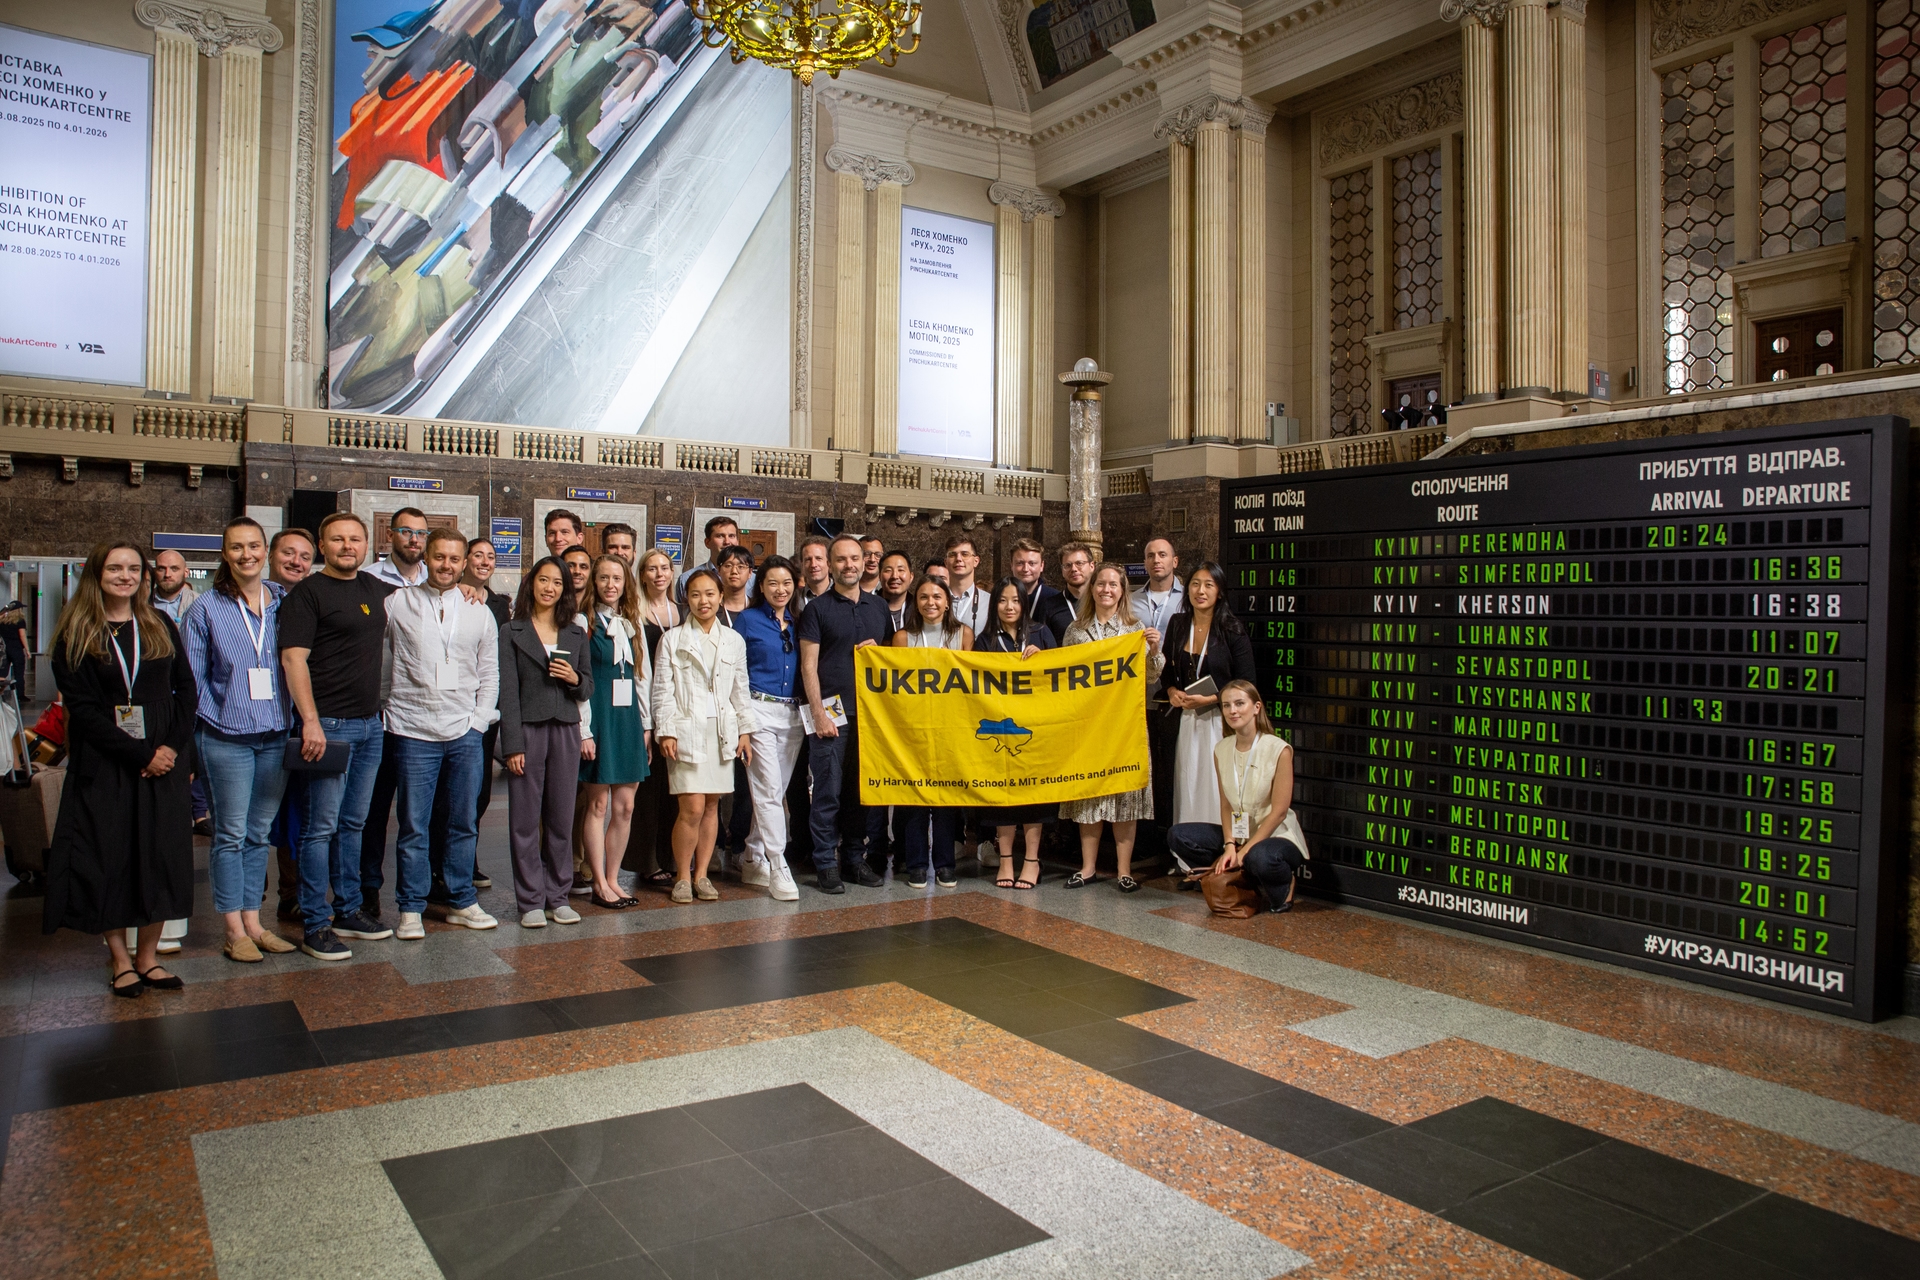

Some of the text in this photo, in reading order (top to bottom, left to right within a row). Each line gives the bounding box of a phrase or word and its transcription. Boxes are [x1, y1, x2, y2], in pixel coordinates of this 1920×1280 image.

[23, 75, 94, 99] ХОМЕНКО
[63, 124, 107, 138] 4.01.2026
[1, 185, 86, 208] HIBITION OF
[0, 202, 128, 231] SIA KHOMENKO AT
[910, 227, 968, 246] ЛЕСЯ ХОМЕНКО
[937, 244, 955, 255] 2025
[11, 245, 61, 259] 28.08.2025
[64, 252, 76, 260] TO
[79, 254, 121, 267] 4.01.2026
[918, 258, 952, 269] ЗАМОВЛЕННЯ
[909, 265, 959, 279] PINCHUKARTCENTRE
[909, 319, 974, 337] LESIA KHOMENKO
[909, 331, 961, 346] MOTION, 2025
[908, 348, 947, 360] COMMISSIONED
[908, 357, 958, 370] PINCHUKARTCENTRE
[1235, 447, 1845, 509] КОЛІЯ ПОЇЗД СПОЛУЧЕННЯ ПРИБУТТЯ ВІДПРАВ.
[1235, 481, 1850, 532] TRACK TRAIN ROUTE ARRIVAL DEPARTURE
[1251, 545, 1255, 560] 1
[1269, 543, 1294, 559] 111
[1375, 537, 1418, 556] KYIV
[1460, 531, 1565, 553] PEREMOHA
[1648, 524, 1726, 547] 20:24
[1241, 571, 1256, 586] 10
[1269, 570, 1295, 586] 146
[1374, 567, 1417, 584] KYIV
[1459, 563, 1592, 584] SIMFEROPOL
[1753, 557, 1840, 580] 16:36
[1248, 594, 1256, 612] 2
[1269, 596, 1295, 613] 102
[1374, 595, 1417, 613] KYIV
[1459, 595, 1549, 614] KHERSON
[1753, 594, 1840, 617] 16:38
[1267, 622, 1295, 639] 520
[1372, 624, 1416, 642] KYIV
[1458, 626, 1548, 646] LUHANSK
[865, 652, 1138, 695] UKRAINE TREK
[1276, 649, 1295, 666] 28
[1372, 652, 1415, 672] KYIV
[1456, 656, 1590, 680] SEVASTOPOL
[1275, 676, 1293, 693] 45
[1371, 681, 1415, 700] KYIV
[1457, 685, 1590, 712] LYSYCHANSK
[1265, 700, 1293, 719] 584
[1371, 709, 1414, 729] KYIV
[1454, 716, 1559, 742] MARIUPOL
[1748, 739, 1835, 766] 16:57
[868, 761, 1140, 789] by Harvard Kennedy School & MIT students and alumni
[1369, 738, 1413, 758] KYIV
[1454, 746, 1602, 777] YEVPATORII
[1746, 775, 1833, 804] 17:58
[1368, 766, 1412, 787] KYIV
[1453, 776, 1542, 804] DONETSK
[1745, 811, 1832, 843] 19:25
[1368, 794, 1411, 816] KYIV
[1450, 805, 1569, 840] MELITOPOL
[1744, 847, 1829, 880] 19:25
[1366, 822, 1409, 846] KYIV
[1450, 835, 1568, 873] BERDIANSK
[1739, 882, 1824, 917] 20:01
[1365, 850, 1408, 874] KYIV
[1450, 865, 1511, 894] KERCH
[1739, 918, 1828, 955] 14:52
[1398, 885, 1528, 925] #ЗАЛІЗНІЗМІНИ
[1644, 934, 1845, 993] #УКРЗАЛІЗНИЦЯ
